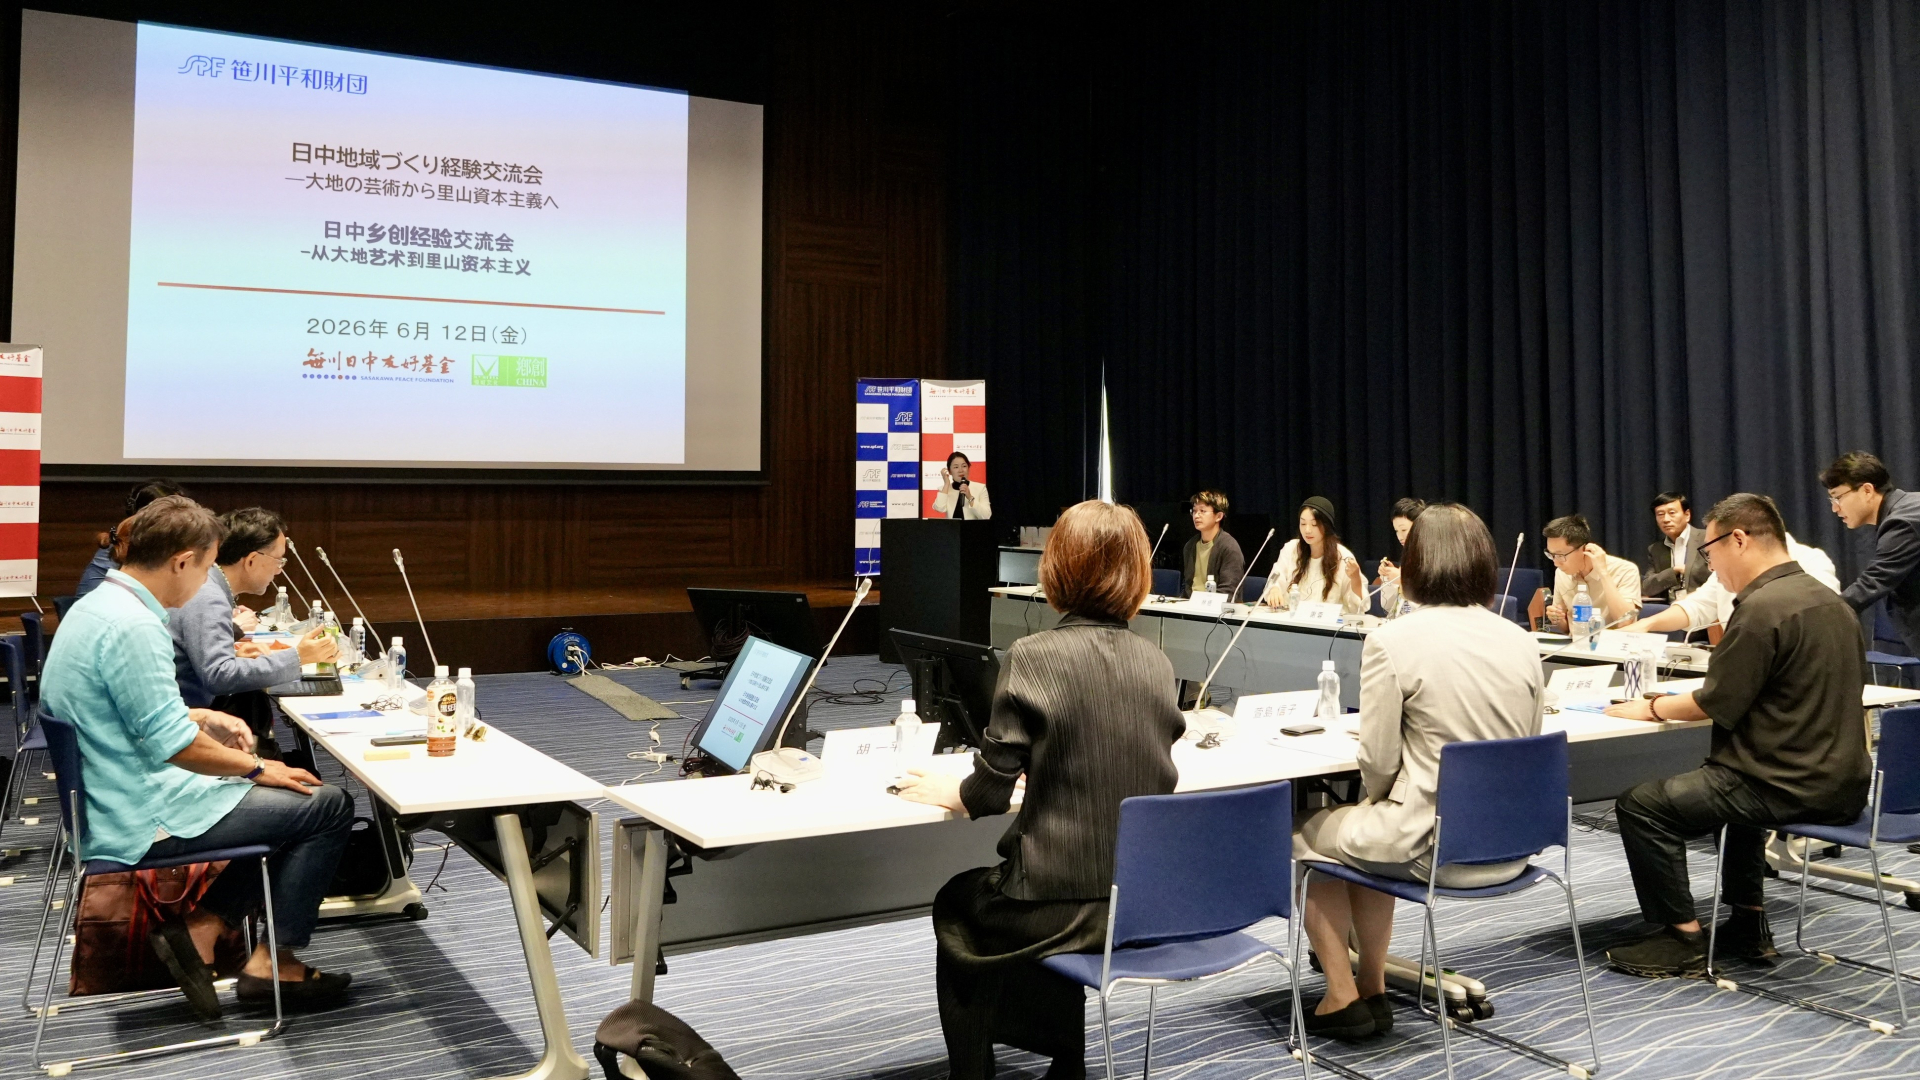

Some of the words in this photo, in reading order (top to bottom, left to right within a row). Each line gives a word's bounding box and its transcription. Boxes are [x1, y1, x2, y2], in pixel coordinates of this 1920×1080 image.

[177, 54, 226, 79] SPF
[230, 59, 368, 96] 笹川平和財団
[292, 141, 544, 186] 日中地域づくり経験交流会
[324, 220, 515, 254] 日中乡创经验交流会
[306, 317, 389, 340] 2026年
[396, 321, 430, 341] 6月
[302, 347, 456, 374] 笹川日中友好基金
[516, 379, 546, 387] CHINA
[895, 412, 913, 422] SPF
[863, 469, 881, 479] SPF
